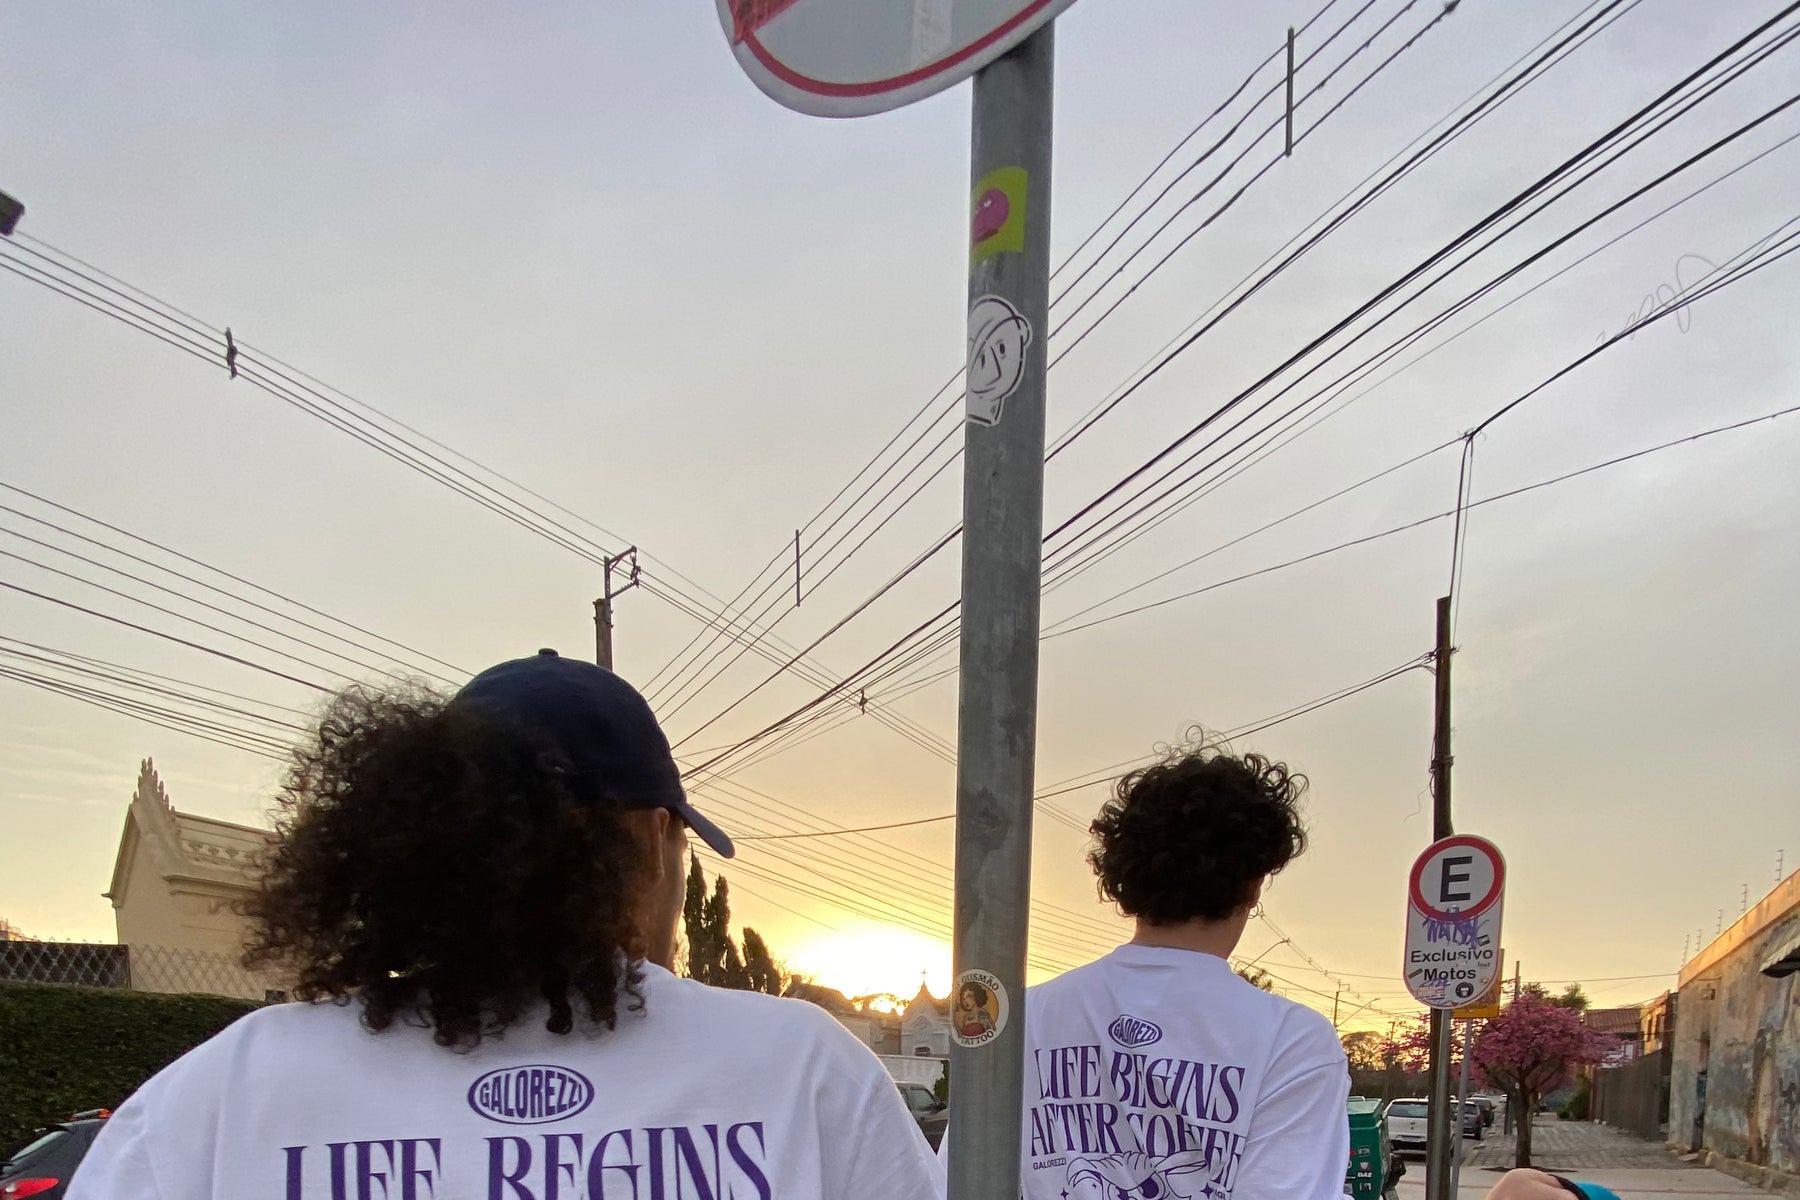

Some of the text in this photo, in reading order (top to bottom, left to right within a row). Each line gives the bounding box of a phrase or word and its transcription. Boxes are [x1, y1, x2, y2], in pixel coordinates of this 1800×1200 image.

[1440, 856, 1472, 903] E
[1411, 948, 1493, 963] Exclusivo
[1424, 967, 1476, 981] Motos
[480, 1069, 583, 1118] GALOREZZI
[1034, 1045, 1246, 1124] LIFE BEGINS
[1030, 1103, 1122, 1157] AFTER
